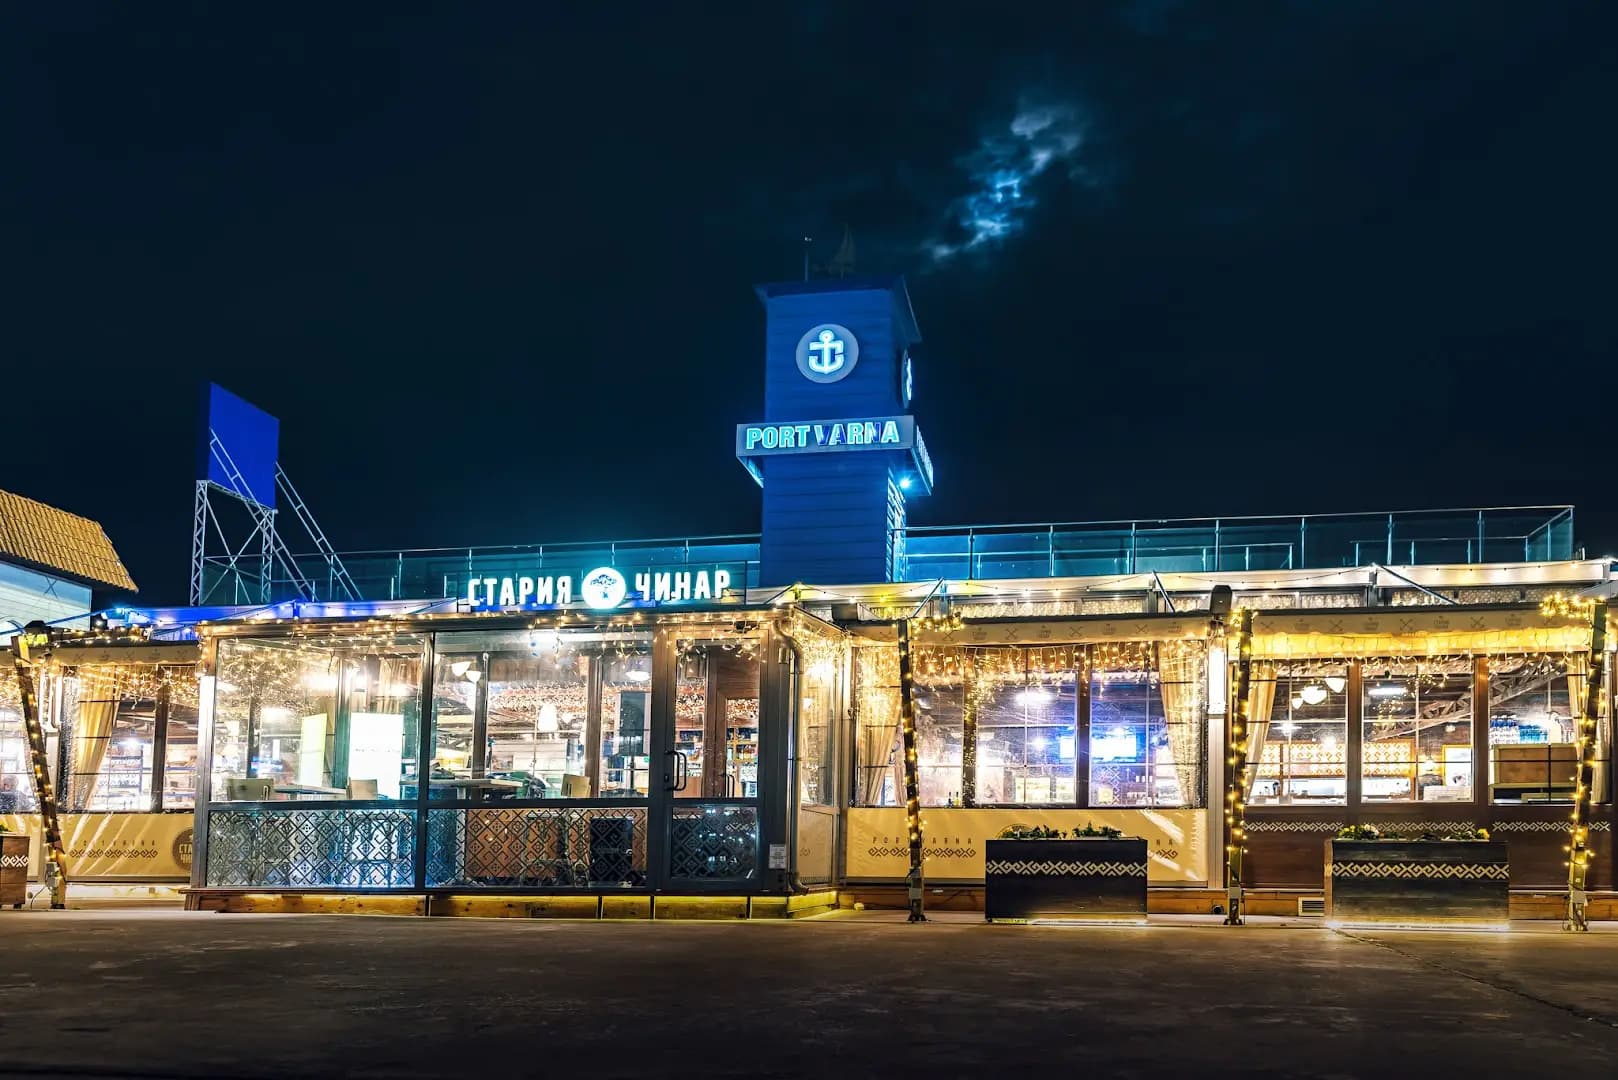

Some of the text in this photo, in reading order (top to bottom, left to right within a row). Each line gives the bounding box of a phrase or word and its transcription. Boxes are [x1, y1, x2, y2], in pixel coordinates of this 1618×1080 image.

[746, 420, 900, 449] PORT VARNA
[468, 570, 731, 606] СТАРИЯ ЧИНАР
